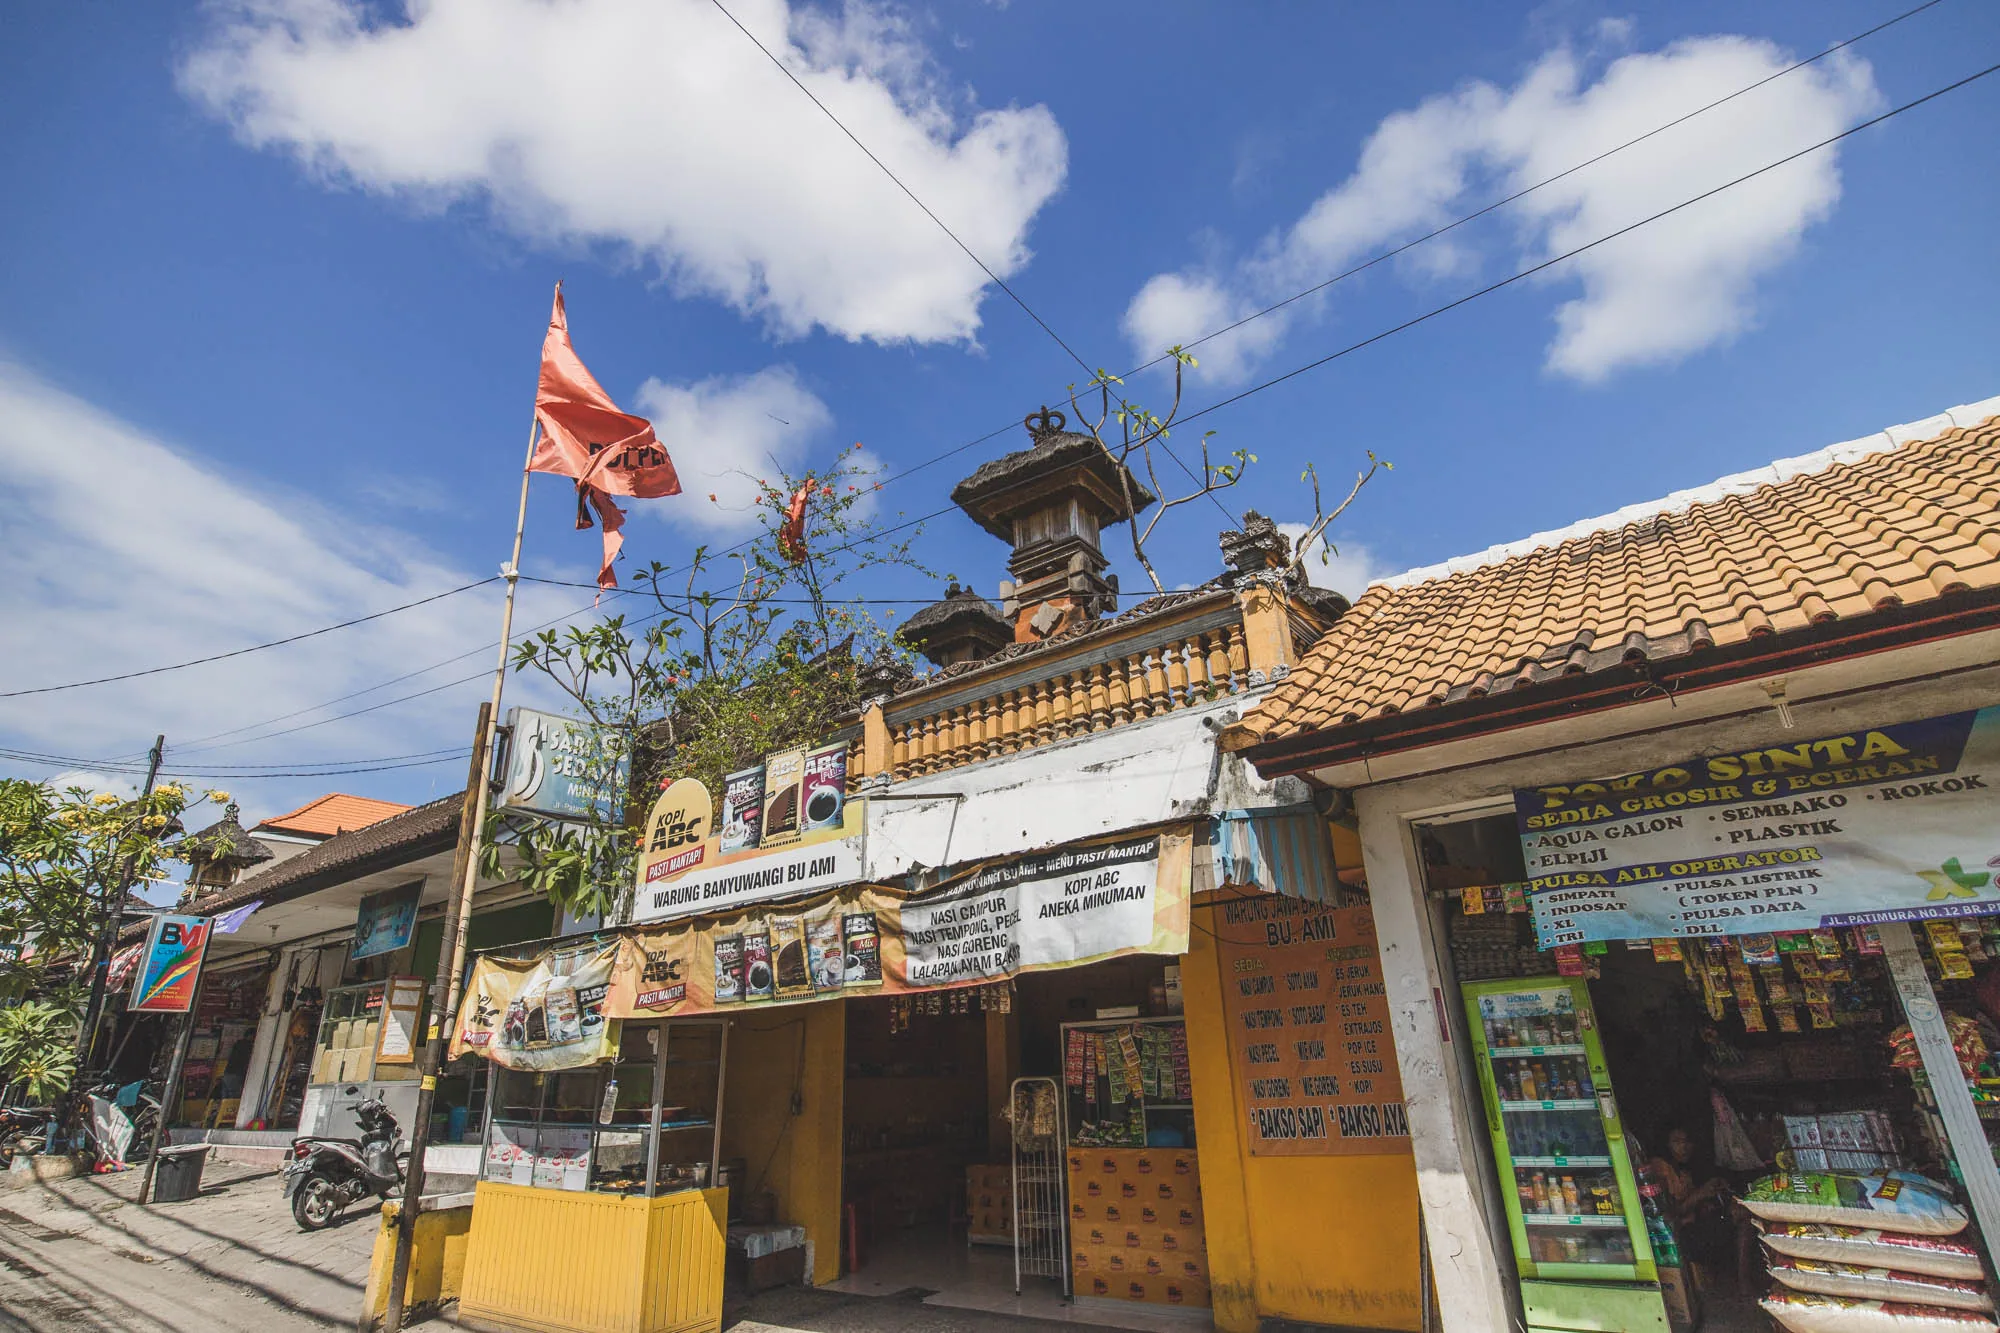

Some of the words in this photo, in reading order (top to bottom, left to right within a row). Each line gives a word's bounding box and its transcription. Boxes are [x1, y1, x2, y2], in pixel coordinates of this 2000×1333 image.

[804, 752, 844, 776] ABC
[1708, 731, 1911, 781] SINTA
[1527, 804, 1615, 829] SEDIA
[1620, 784, 1744, 813] GROSIR
[1751, 779, 1777, 796] &
[1789, 756, 1940, 790] ECERAN
[1879, 774, 1989, 801] ROKOK
[656, 808, 685, 828] KOPI
[1722, 794, 1849, 823] SEMBAKO
[649, 817, 702, 852] ABC
[1537, 829, 1600, 848] AQUA
[1604, 815, 1684, 839] GALON
[1728, 818, 1844, 844] PLASTIK
[649, 864, 669, 880] PASTI
[669, 848, 702, 873] MANTAP!
[1019, 863, 1037, 877] AMI
[1046, 857, 1074, 872] MENU
[1076, 850, 1106, 865] PASTI
[1108, 841, 1154, 859] MANTAP
[1531, 873, 1610, 892] PULSA
[1616, 865, 1665, 884] ALL
[1669, 846, 1823, 876] OPERATOR
[1540, 848, 1609, 867] ELPIJI
[653, 884, 700, 909] WARUNG
[703, 866, 784, 898] BANYUWANGI
[787, 862, 806, 882] BU
[809, 855, 836, 879] AMI
[1065, 877, 1092, 896] KOPI
[1094, 870, 1120, 890] ABC
[1674, 878, 1738, 892] PULSA
[1741, 868, 1824, 886] LISTRIK
[1039, 898, 1080, 919] ANEKA
[1082, 885, 1146, 911] MINUMAN
[1548, 890, 1617, 903] SIMPATI
[1691, 889, 1759, 905] TOKEN
[1765, 884, 1804, 898] PLN
[931, 909, 957, 926] NASI
[960, 897, 1007, 920] CAMPUR
[1225, 900, 1269, 925] WARUNG
[1271, 897, 1300, 919] JAWA
[1550, 902, 1628, 917] INDOSAT
[1682, 906, 1746, 921] PULSA
[1750, 901, 1807, 915] DATA
[1828, 915, 1847, 926] JL.
[1848, 910, 1918, 924] PATIMURA
[1918, 907, 1943, 919] NO.
[1945, 906, 1961, 917] 12
[1962, 904, 1986, 915] BR.
[911, 929, 937, 945] NASI
[937, 918, 993, 942] TEMPONG,
[996, 909, 1022, 930] PECEL
[1267, 920, 1298, 946] BU.
[1302, 913, 1336, 943] AMI
[1553, 919, 1576, 930] XL
[1685, 924, 1724, 935] DLL
[859, 939, 874, 949] Mix
[937, 942, 960, 960] NASI
[962, 933, 1007, 955] GORENG
[1555, 931, 1585, 943] TRI
[641, 959, 681, 983] ABC
[1233, 959, 1264, 973] SEDIA
[1336, 967, 1345, 980] ES
[1346, 965, 1370, 979] JERUK
[1287, 971, 1302, 991] SOTO
[1338, 984, 1361, 998] JERUK
[638, 992, 658, 1005] PASTI
[658, 986, 684, 1001] MANTAP!
[1292, 1006, 1308, 1025] SOTO
[1341, 1004, 1351, 1017] ES
[1352, 1002, 1367, 1016] TEH
[1344, 1020, 1383, 1035] EXTRAJOS
[1347, 1041, 1362, 1054] POP
[1364, 1040, 1377, 1053] ICE
[1351, 1062, 1361, 1074] ES
[1362, 1060, 1383, 1073] SUSU
[1354, 1079, 1374, 1094] KOPI
[1258, 1107, 1297, 1139] BAKSO
[1297, 1105, 1327, 1139] SAPI
[1337, 1104, 1382, 1137] BAKSO
